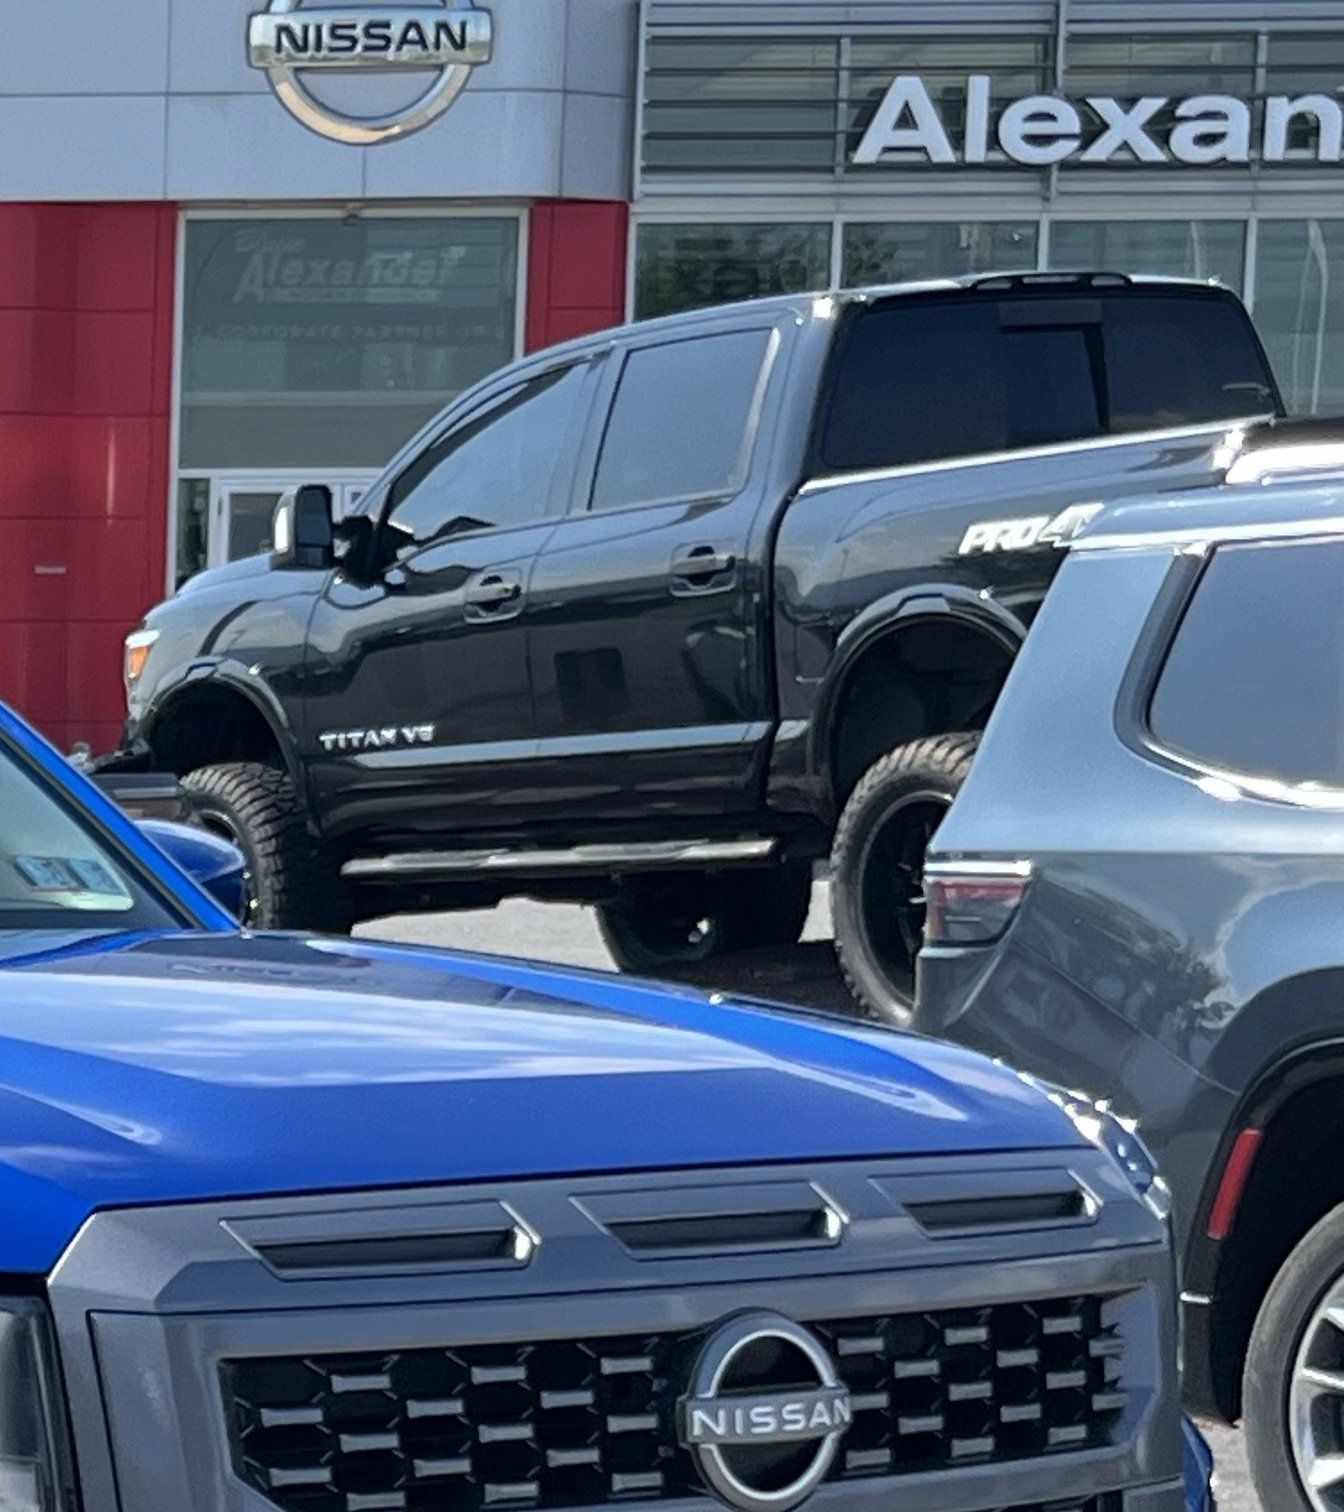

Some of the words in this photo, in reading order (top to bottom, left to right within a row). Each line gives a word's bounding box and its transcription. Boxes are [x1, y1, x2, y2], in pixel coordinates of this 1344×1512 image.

[274, 18, 468, 54] NISSAN
[851, 74, 1344, 165] Alexan
[319, 727, 397, 751] TITAN
[692, 1397, 851, 1436] NISSAN
